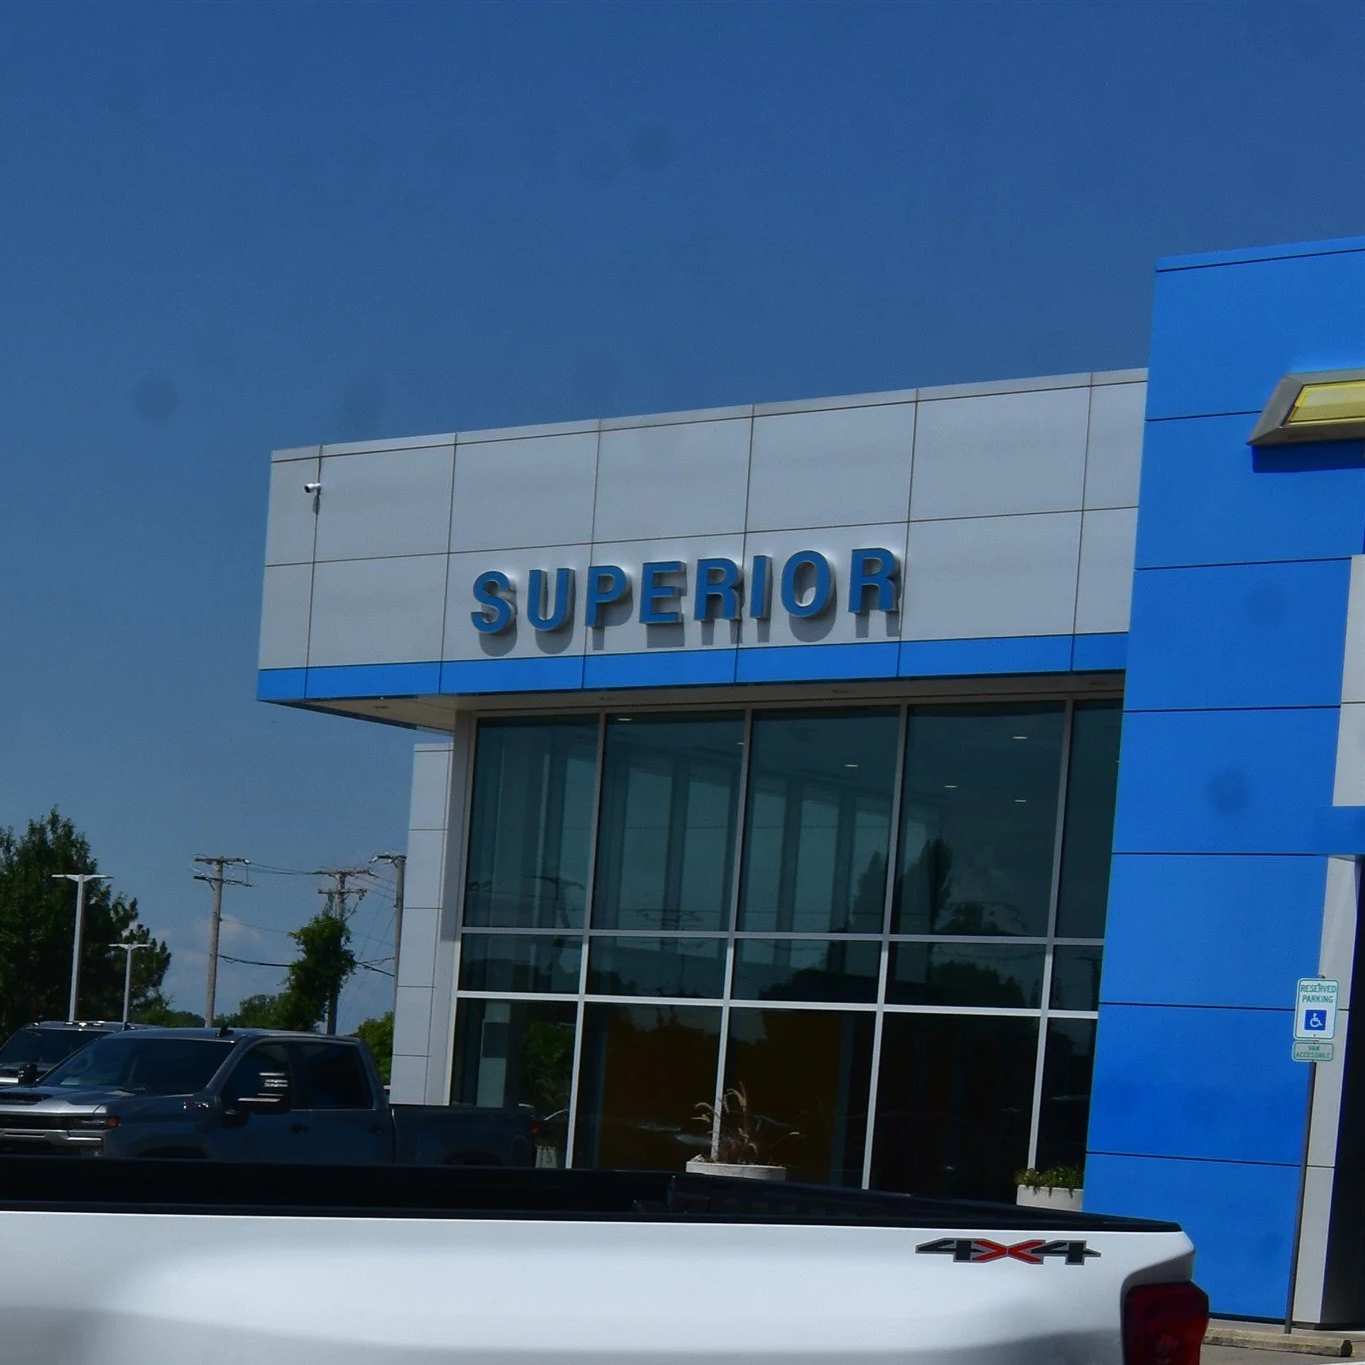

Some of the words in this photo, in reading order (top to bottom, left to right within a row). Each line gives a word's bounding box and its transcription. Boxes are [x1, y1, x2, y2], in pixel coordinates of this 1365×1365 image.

[470, 547, 899, 634] SUPERIOR
[1300, 984, 1336, 993] RESERVED
[1302, 995, 1333, 1003] PARKING
